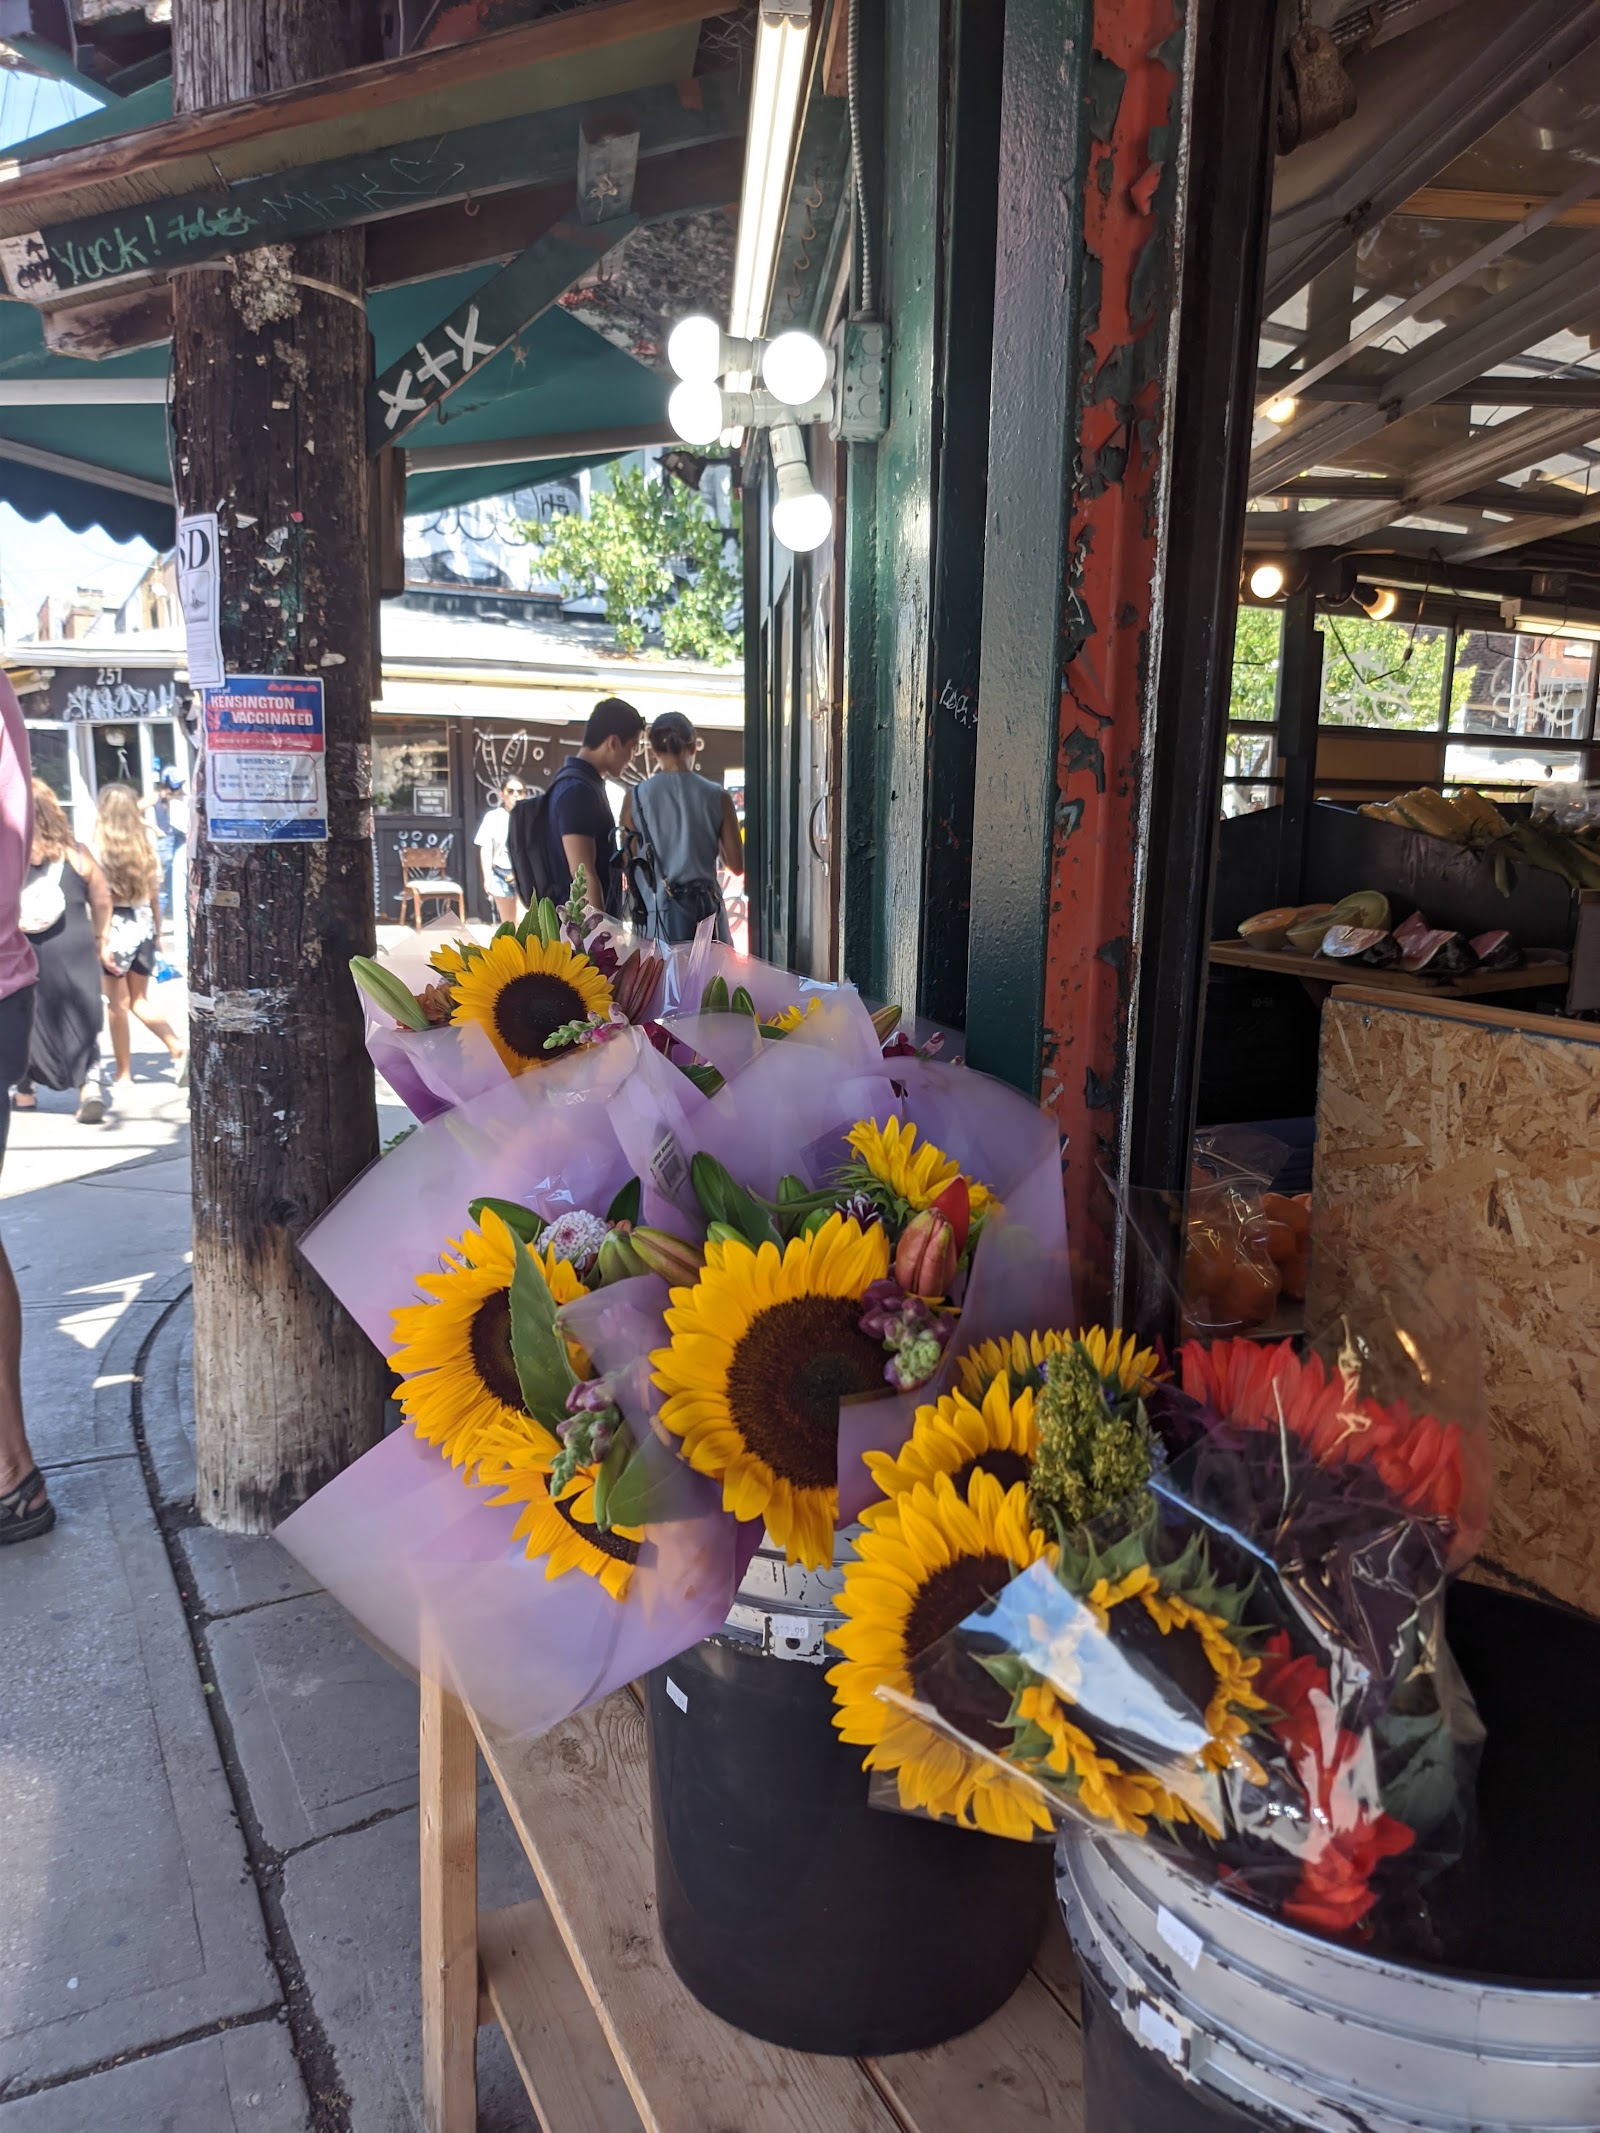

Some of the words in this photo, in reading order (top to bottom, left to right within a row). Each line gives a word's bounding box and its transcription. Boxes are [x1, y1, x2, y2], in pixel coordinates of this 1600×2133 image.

[52, 216, 161, 284] YUCK!
[96, 668, 122, 685] 257
[210, 695, 295, 710] KENSINGTON
[230, 711, 314, 726] VACCINATED
